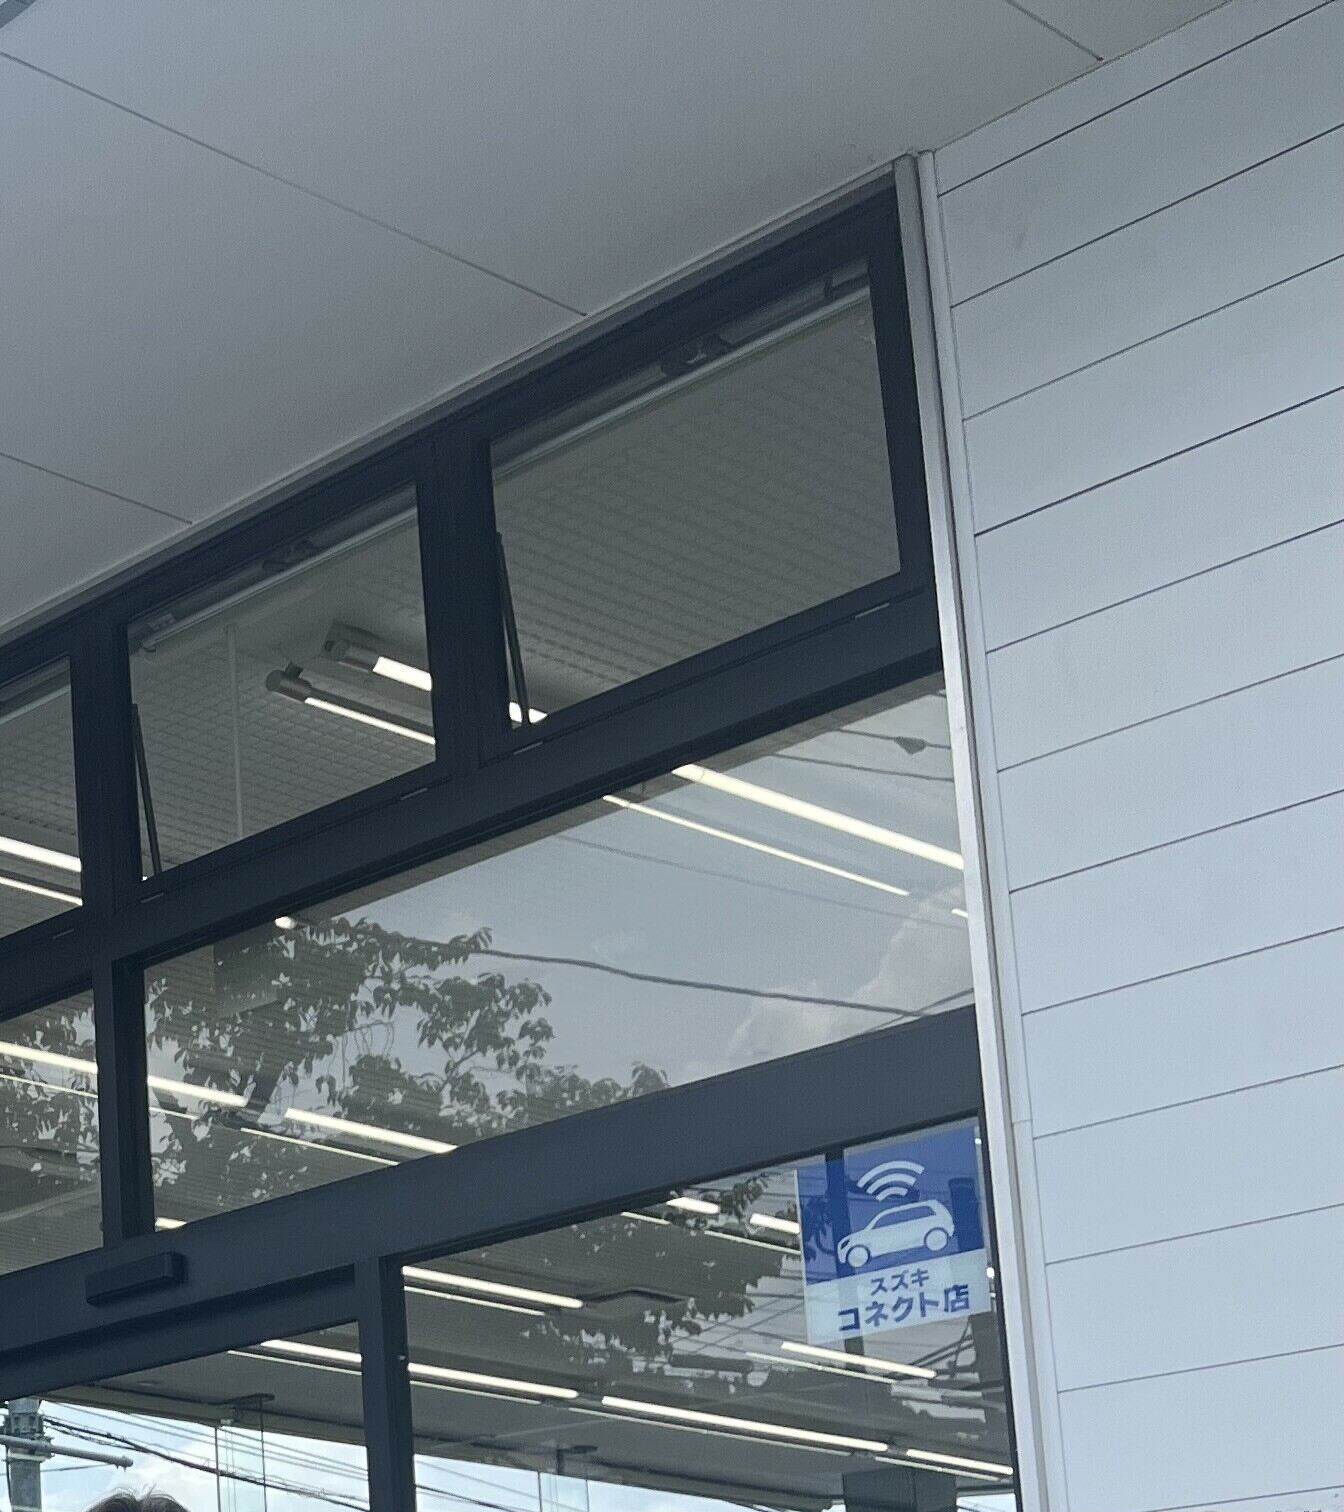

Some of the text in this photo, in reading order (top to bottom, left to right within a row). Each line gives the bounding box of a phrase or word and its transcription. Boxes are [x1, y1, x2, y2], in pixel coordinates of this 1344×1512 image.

[869, 1268, 930, 1295] スズキ
[838, 1284, 971, 1332] コネクト店
